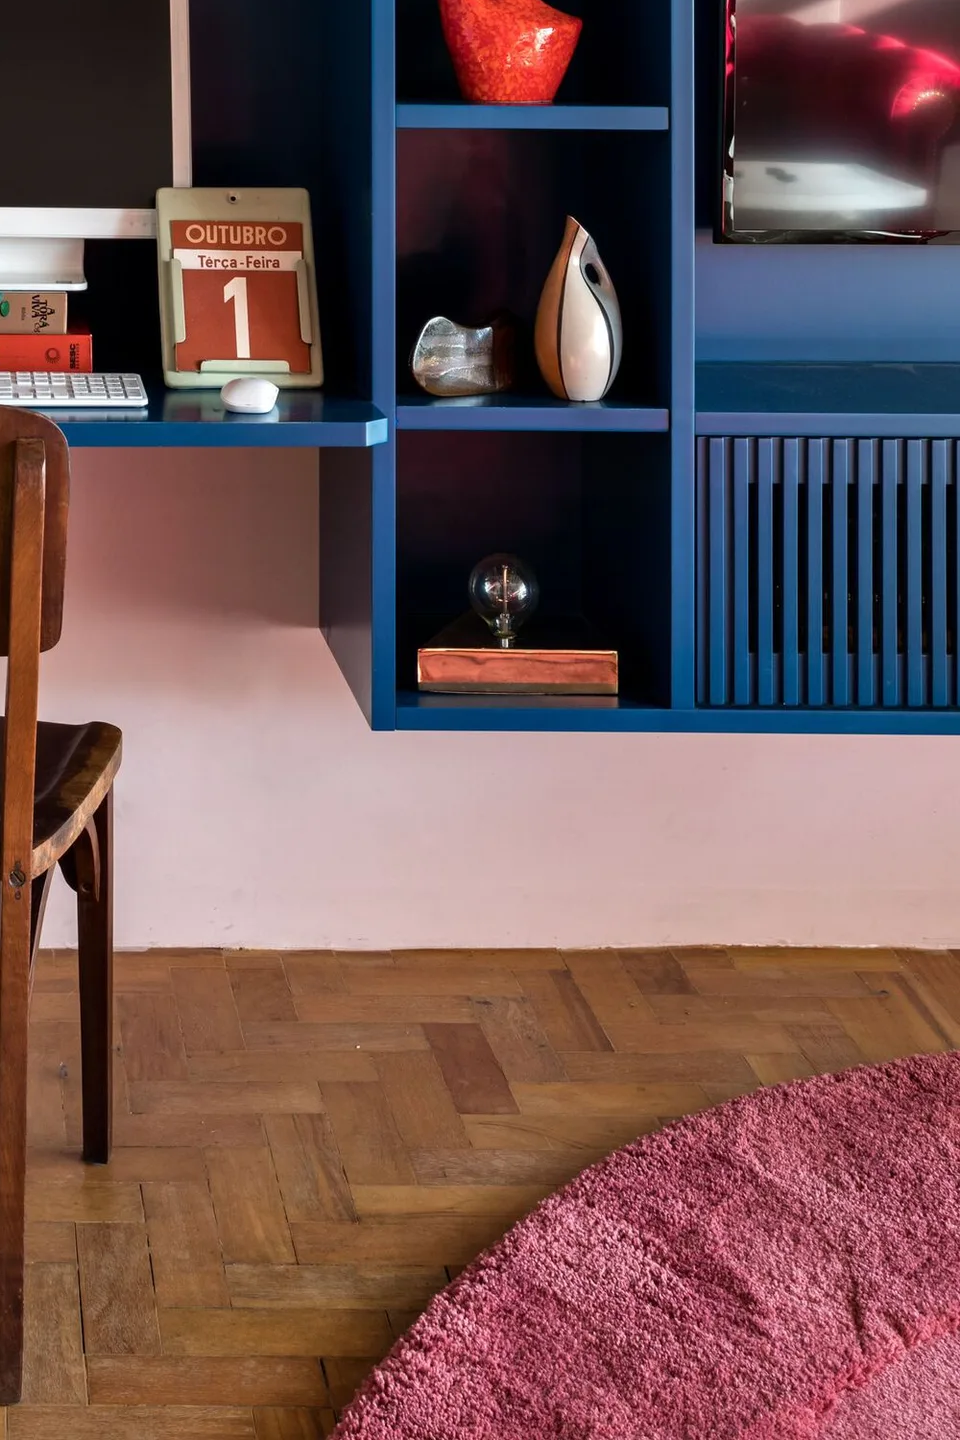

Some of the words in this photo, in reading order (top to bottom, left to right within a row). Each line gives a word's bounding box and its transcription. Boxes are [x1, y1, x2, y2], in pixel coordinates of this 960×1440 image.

[185, 224, 287, 245] OUTUBRO
[31, 295, 40, 318] VIVA
[39, 300, 50, 328] TORÁ
[47, 307, 55, 315] A
[223, 276, 251, 358] 1
[69, 344, 77, 370] SESC
